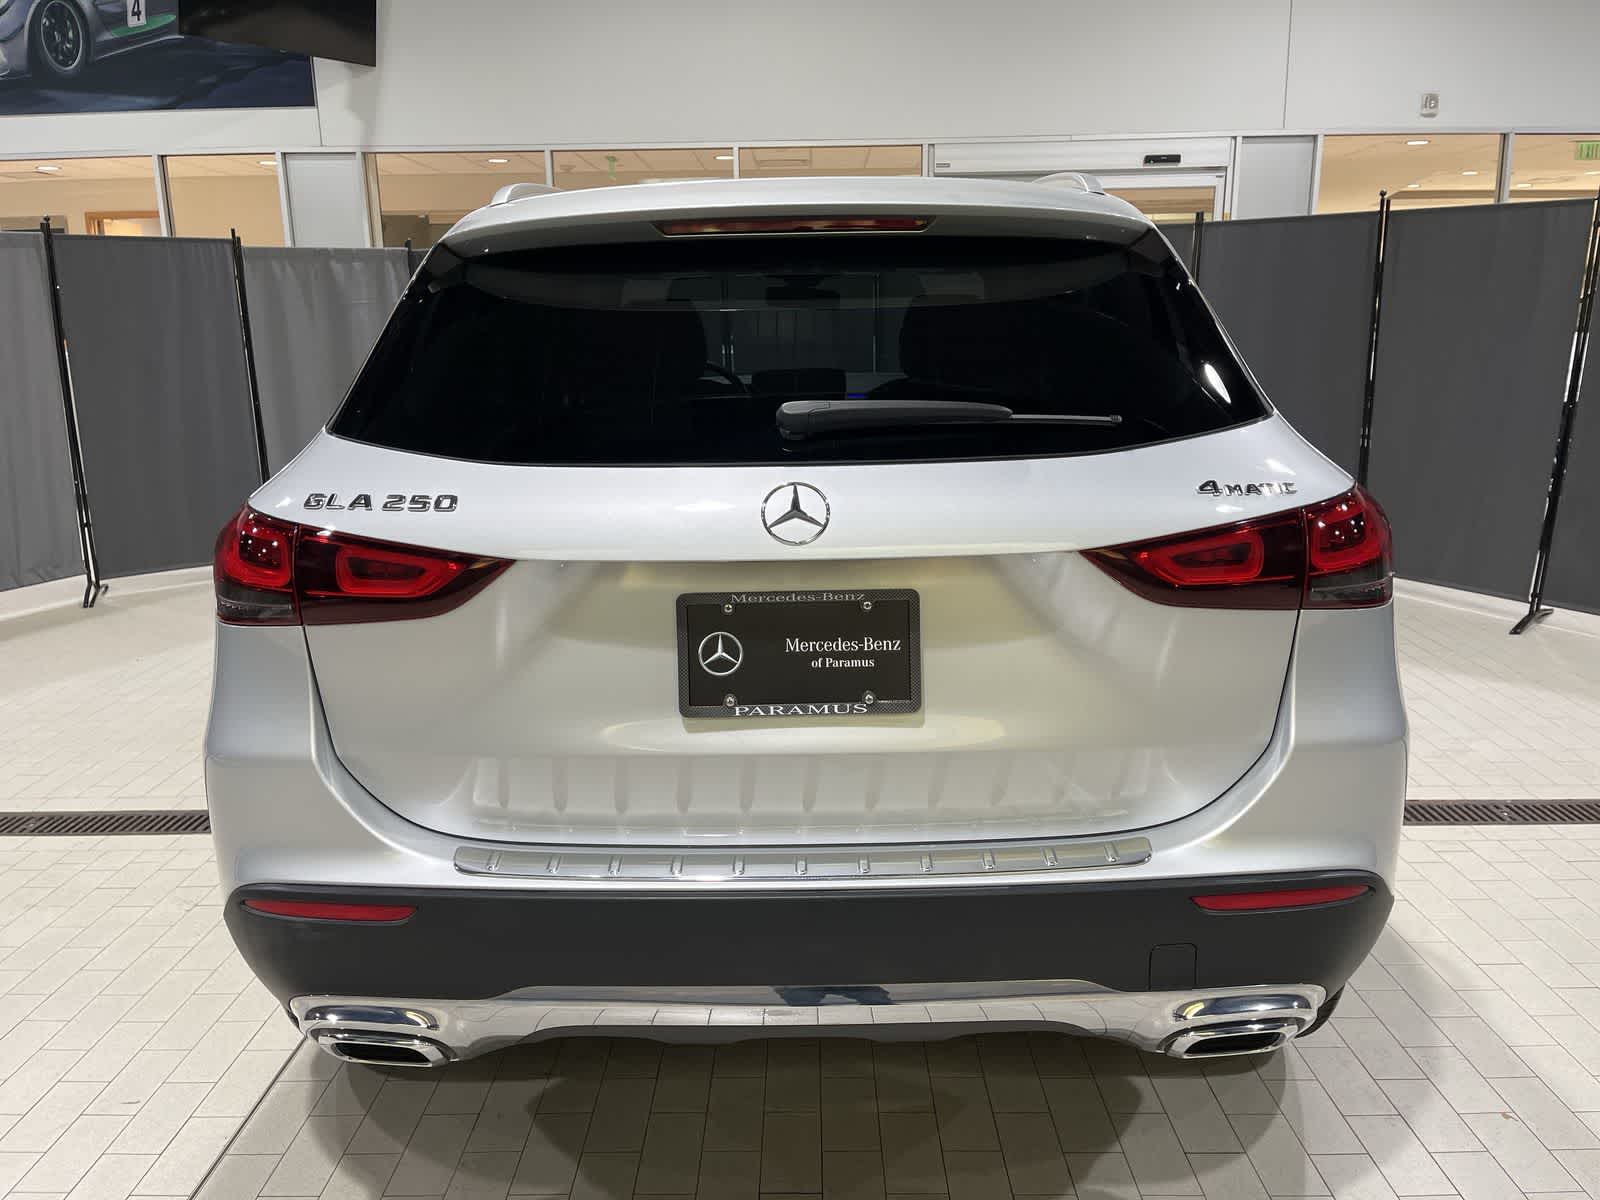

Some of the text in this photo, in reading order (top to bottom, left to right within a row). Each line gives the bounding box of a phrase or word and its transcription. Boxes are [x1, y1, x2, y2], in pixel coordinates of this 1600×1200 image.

[1197, 480, 1298, 497] 4MATIC
[303, 494, 458, 512] GLA 250
[731, 592, 865, 603] Mercedes-Benz
[785, 638, 901, 652] Mercedes-Benz
[811, 658, 874, 668] of Paramus
[735, 704, 867, 716] PARAMUS
